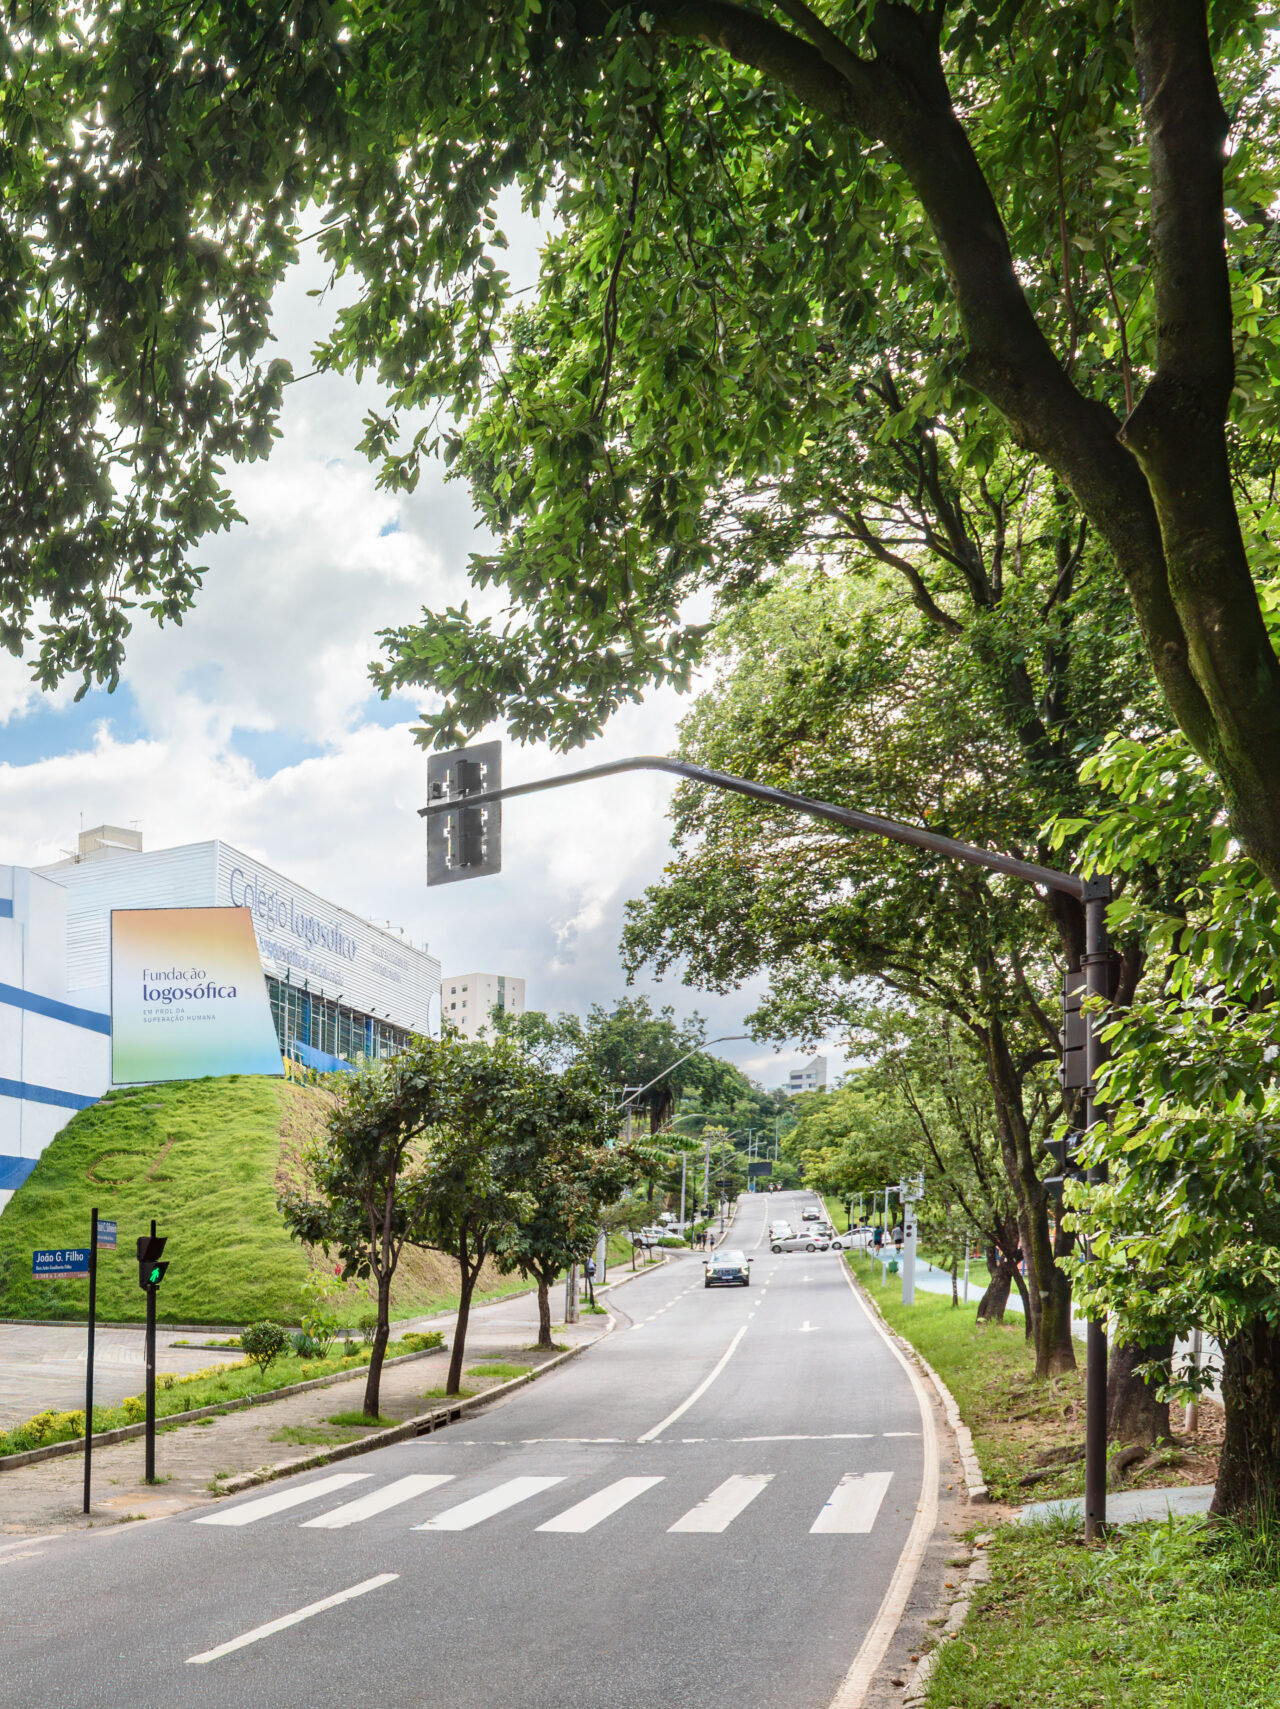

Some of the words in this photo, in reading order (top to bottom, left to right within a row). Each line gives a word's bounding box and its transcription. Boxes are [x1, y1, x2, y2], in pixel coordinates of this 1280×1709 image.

[230, 868, 287, 932] Colégio
[143, 967, 206, 982] Fundação
[143, 982, 237, 1005] logosófica
[143, 1015, 184, 1023] SUPERAÇÃO
[36, 1252, 54, 1263] João
[56, 1251, 63, 1262] G.
[65, 1251, 84, 1261] Filho
